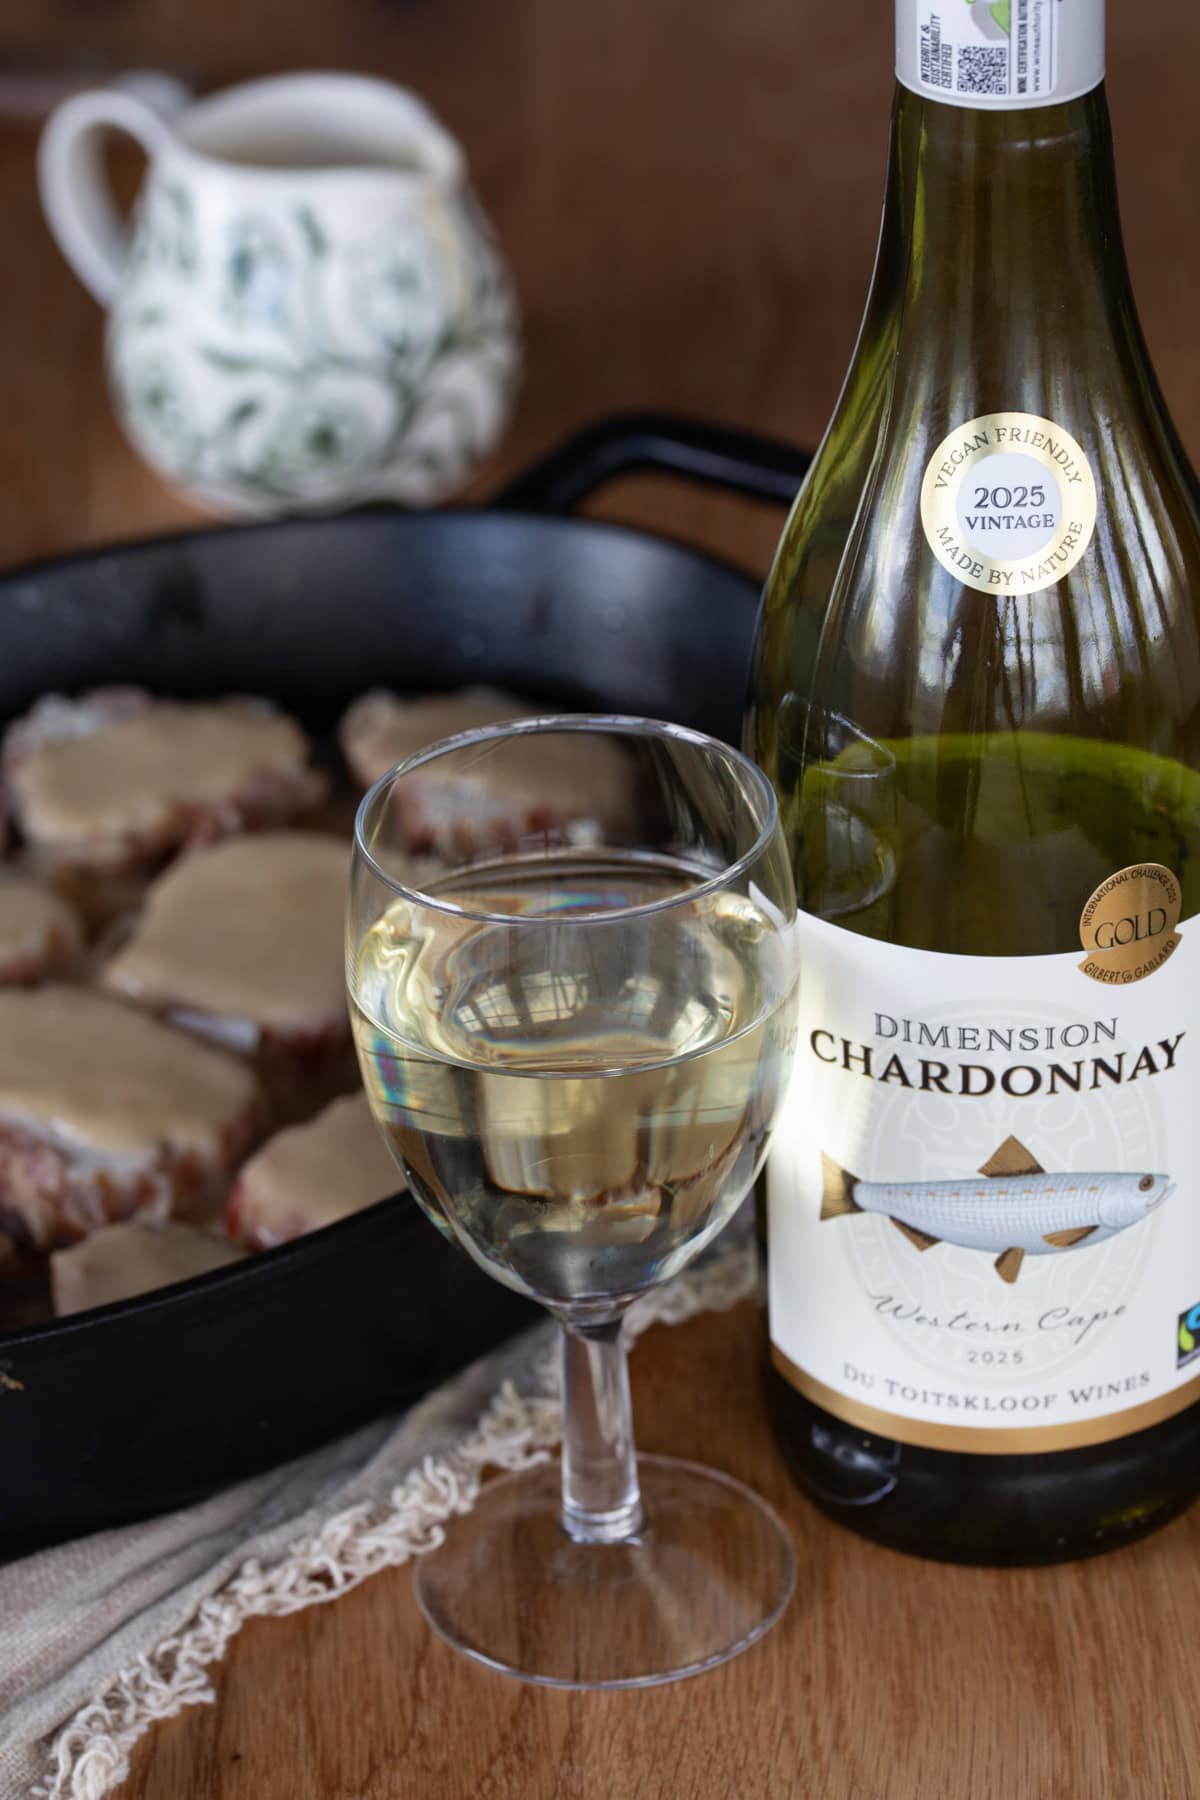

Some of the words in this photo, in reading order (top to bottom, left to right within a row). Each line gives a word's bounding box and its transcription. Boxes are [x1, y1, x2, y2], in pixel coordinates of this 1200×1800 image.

[920, 24, 930, 34] &
[930, 14, 941, 87] SUSTAINABILITY
[1017, 23, 1027, 74] CERTIFICATION
[921, 36, 930, 83] INTEGRITY
[941, 43, 952, 89] CERTIFIED
[1017, 76, 1027, 94] WINE
[934, 431, 990, 489] VEGAN
[994, 427, 1082, 484] FRIENDLY
[973, 485, 1046, 509] 2025
[965, 513, 1055, 530] VINTAGE
[936, 526, 984, 579] MADE
[987, 568, 1014, 586] BY
[1020, 521, 1083, 584] NATURE
[1083, 874, 1129, 928] INTERNATIONAL
[1094, 908, 1167, 949] GOLD
[1084, 962, 1122, 983] GILBERT
[1134, 939, 1175, 979] GAILLARD
[873, 1012, 1120, 1052] DIMENSION
[810, 1029, 1187, 1098] CHARDONNAY
[867, 1291, 1026, 1334] Western
[1037, 1303, 1127, 1345] Cape
[967, 1350, 1024, 1365] 2025
[842, 1362, 874, 1389] DU
[883, 1378, 1058, 1412] TOITSKLOOF
[1068, 1370, 1152, 1405] WINES
